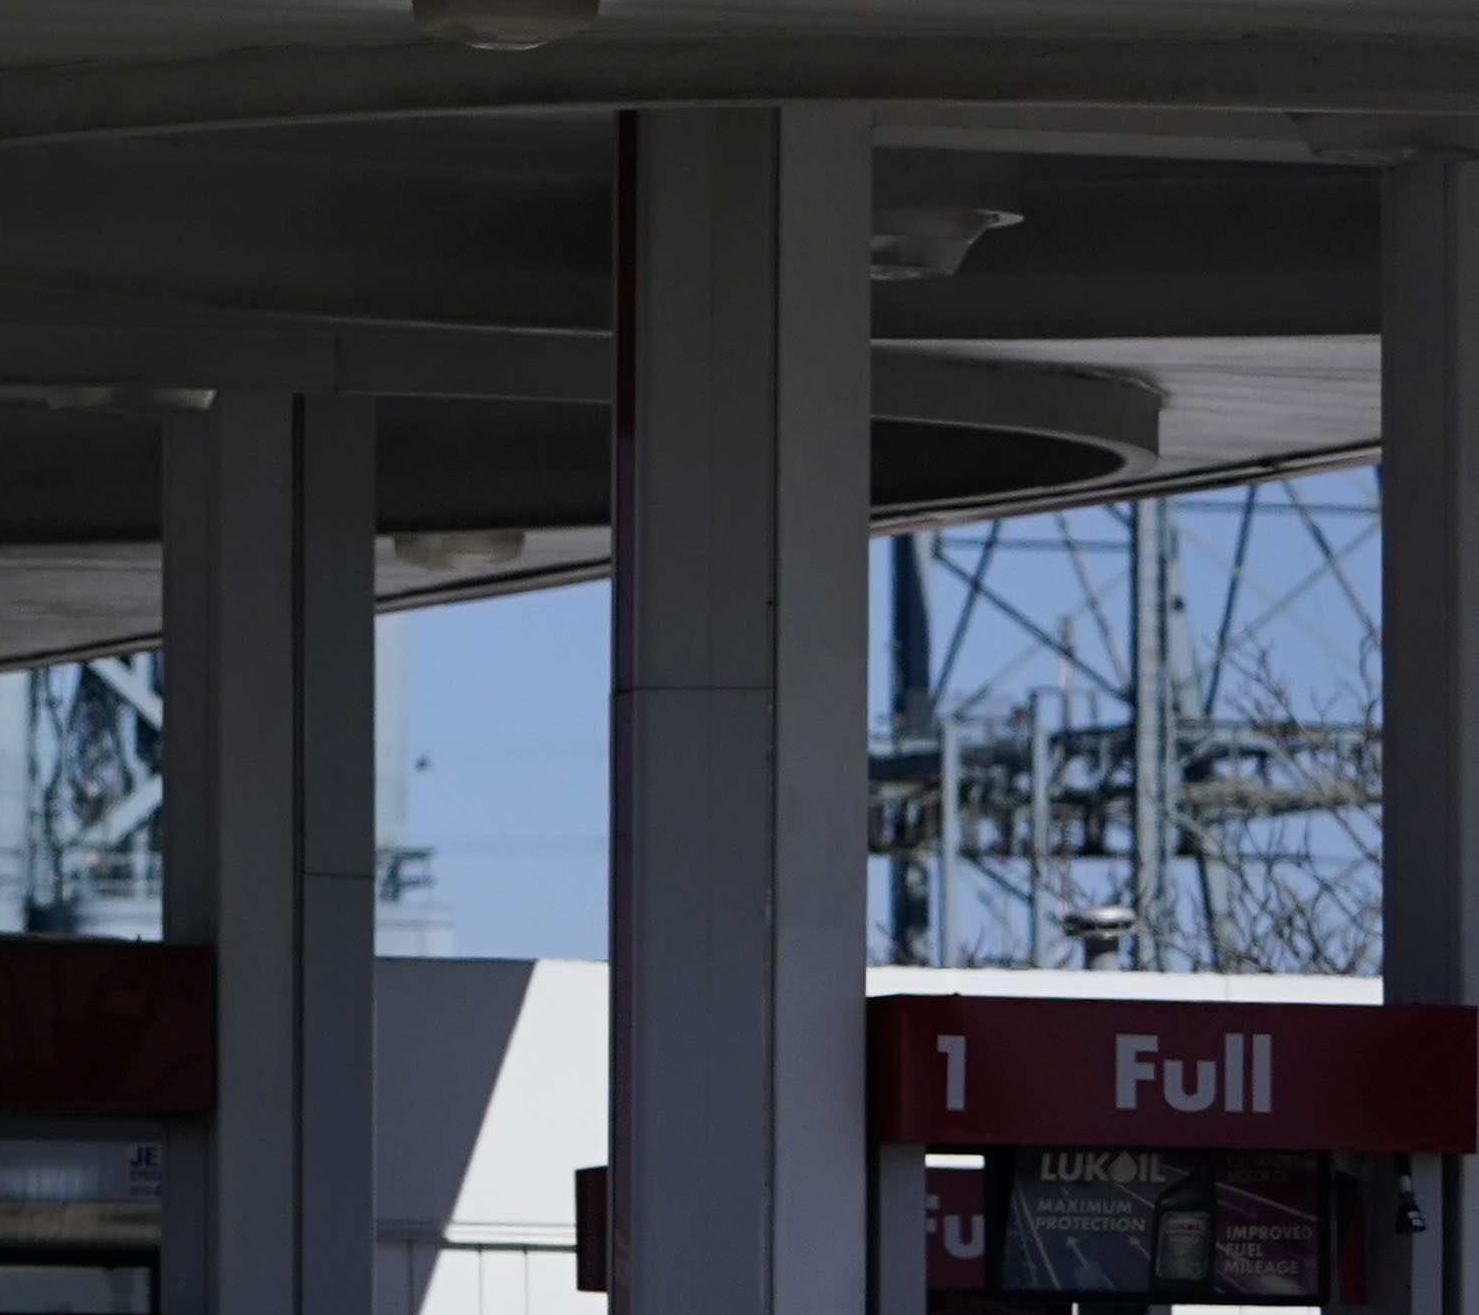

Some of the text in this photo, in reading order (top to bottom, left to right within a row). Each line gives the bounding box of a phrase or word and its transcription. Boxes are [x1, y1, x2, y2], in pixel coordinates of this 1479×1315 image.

[936, 1033, 1272, 1114] 1 Full
[1039, 1149, 1166, 1185] LUKOIL
[1036, 1199, 1134, 1215] MAXIMUM
[1034, 1215, 1147, 1233] PROTECTION
[1226, 1225, 1314, 1241] IMPROVED
[1224, 1242, 1265, 1258] FUEL
[1223, 1260, 1300, 1275] MILEAGE
